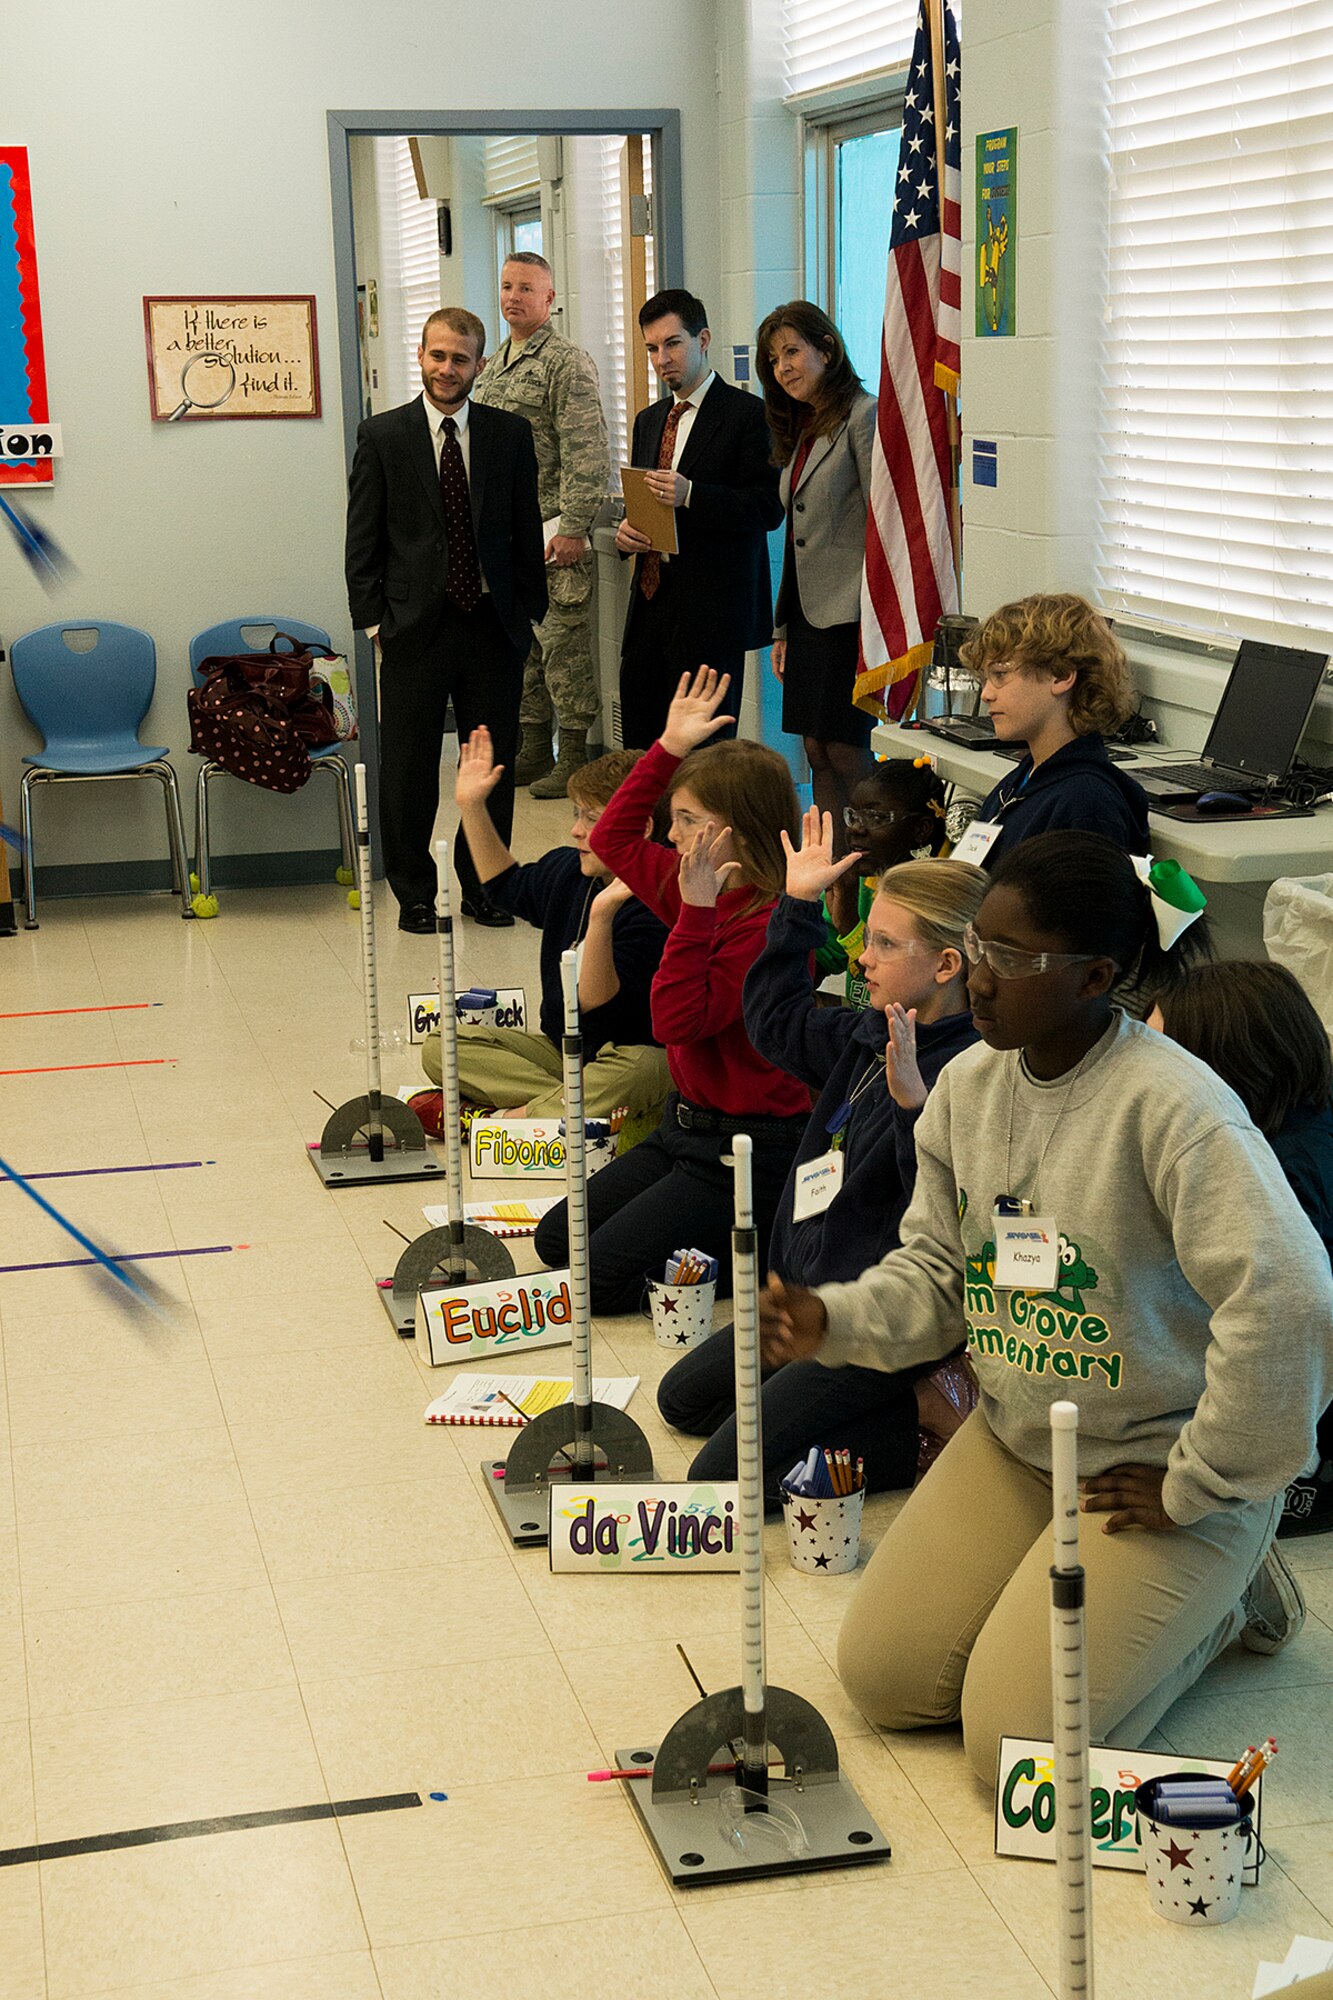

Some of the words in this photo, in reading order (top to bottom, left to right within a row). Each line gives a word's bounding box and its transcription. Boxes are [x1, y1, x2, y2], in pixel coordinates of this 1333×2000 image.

[184, 310, 202, 335] If
[205, 310, 249, 331] there
[253, 315, 268, 330] is
[167, 340, 181, 351] a
[186, 332, 235, 351] better
[240, 372, 279, 397] find
[284, 371, 298, 391] it.
[1013, 1252, 1041, 1266] Khazya
[440, 1281, 572, 1344] Euclid
[1009, 1288, 1111, 1346] Grove
[569, 1499, 619, 1555] da
[638, 1500, 734, 1555] Vinci
